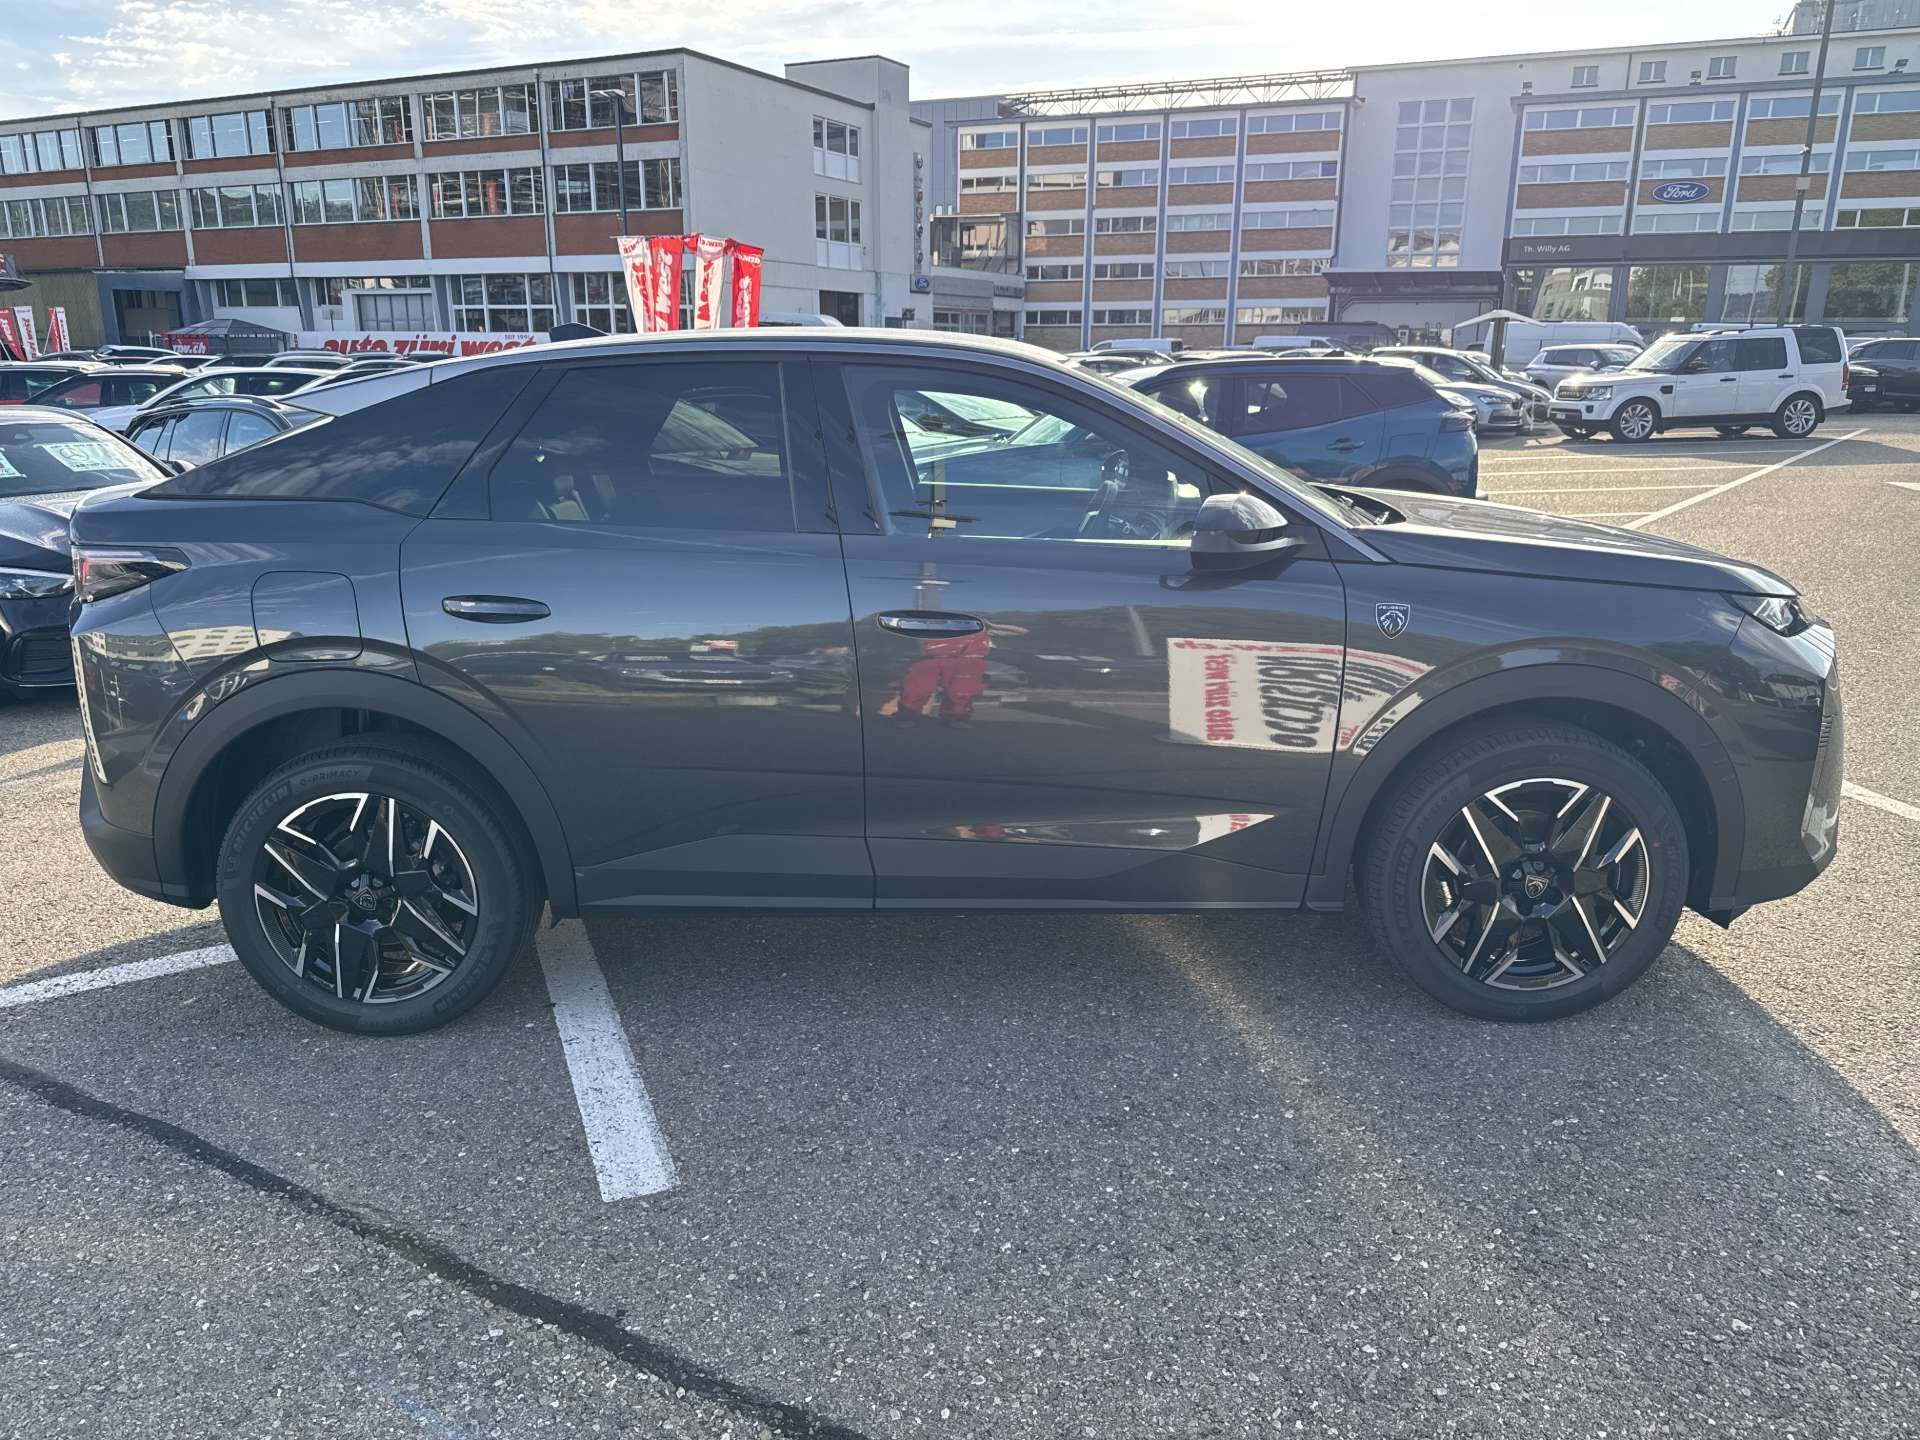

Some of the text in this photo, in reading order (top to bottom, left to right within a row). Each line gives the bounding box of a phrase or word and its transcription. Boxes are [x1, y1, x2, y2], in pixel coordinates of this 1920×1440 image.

[1661, 183, 1699, 200] Ford
[1536, 244, 1557, 254] Willy
[1558, 244, 1570, 253] AG
